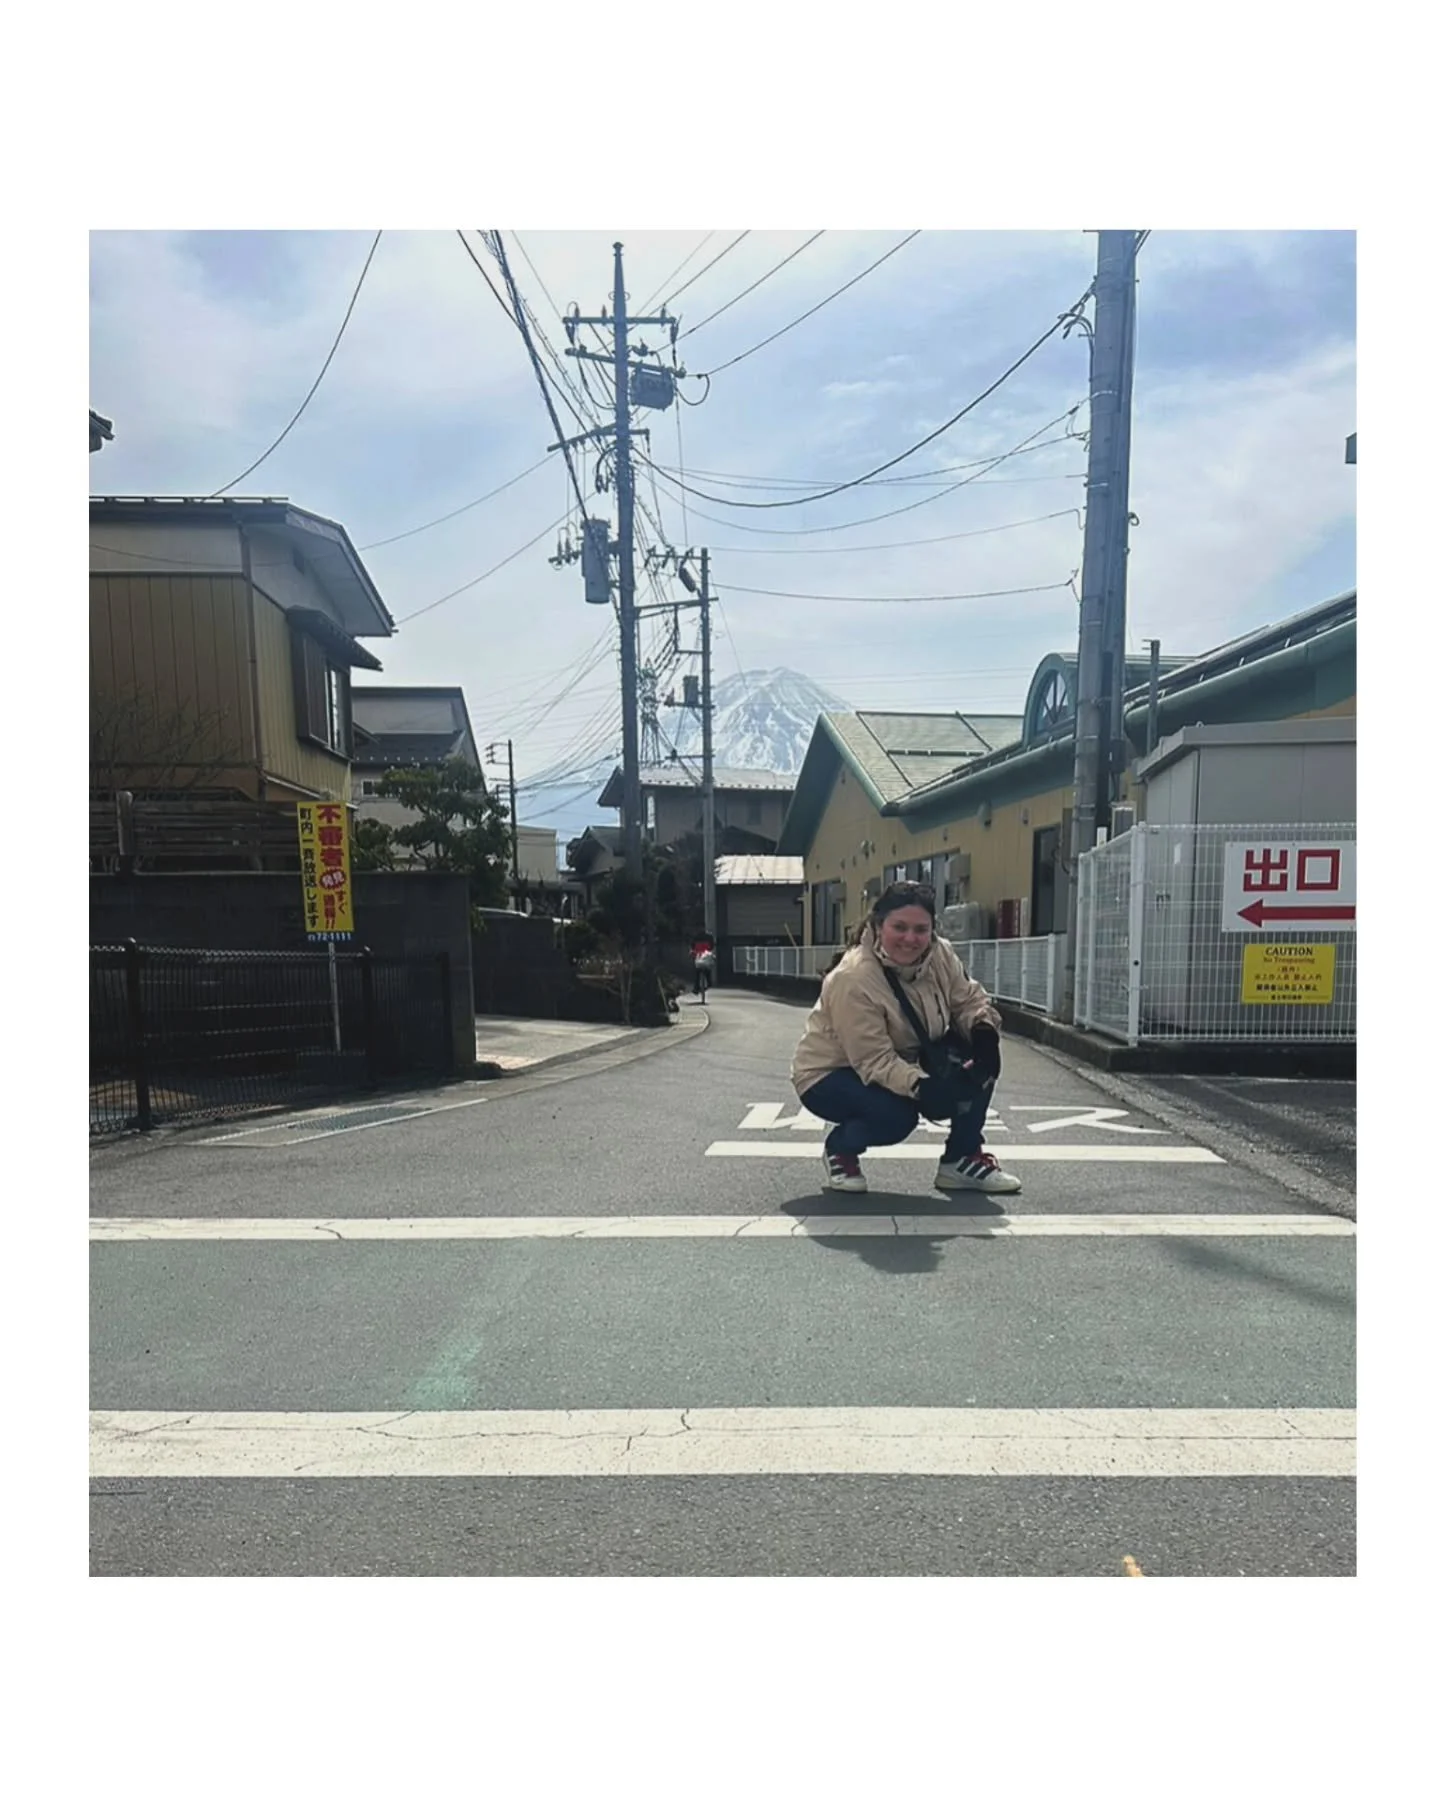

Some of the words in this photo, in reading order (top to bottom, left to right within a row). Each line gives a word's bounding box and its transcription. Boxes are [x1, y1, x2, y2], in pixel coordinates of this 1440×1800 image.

[316, 805, 344, 867] 不審者
[1243, 847, 1341, 892] 出口
[1265, 946, 1314, 956] CAUTION
